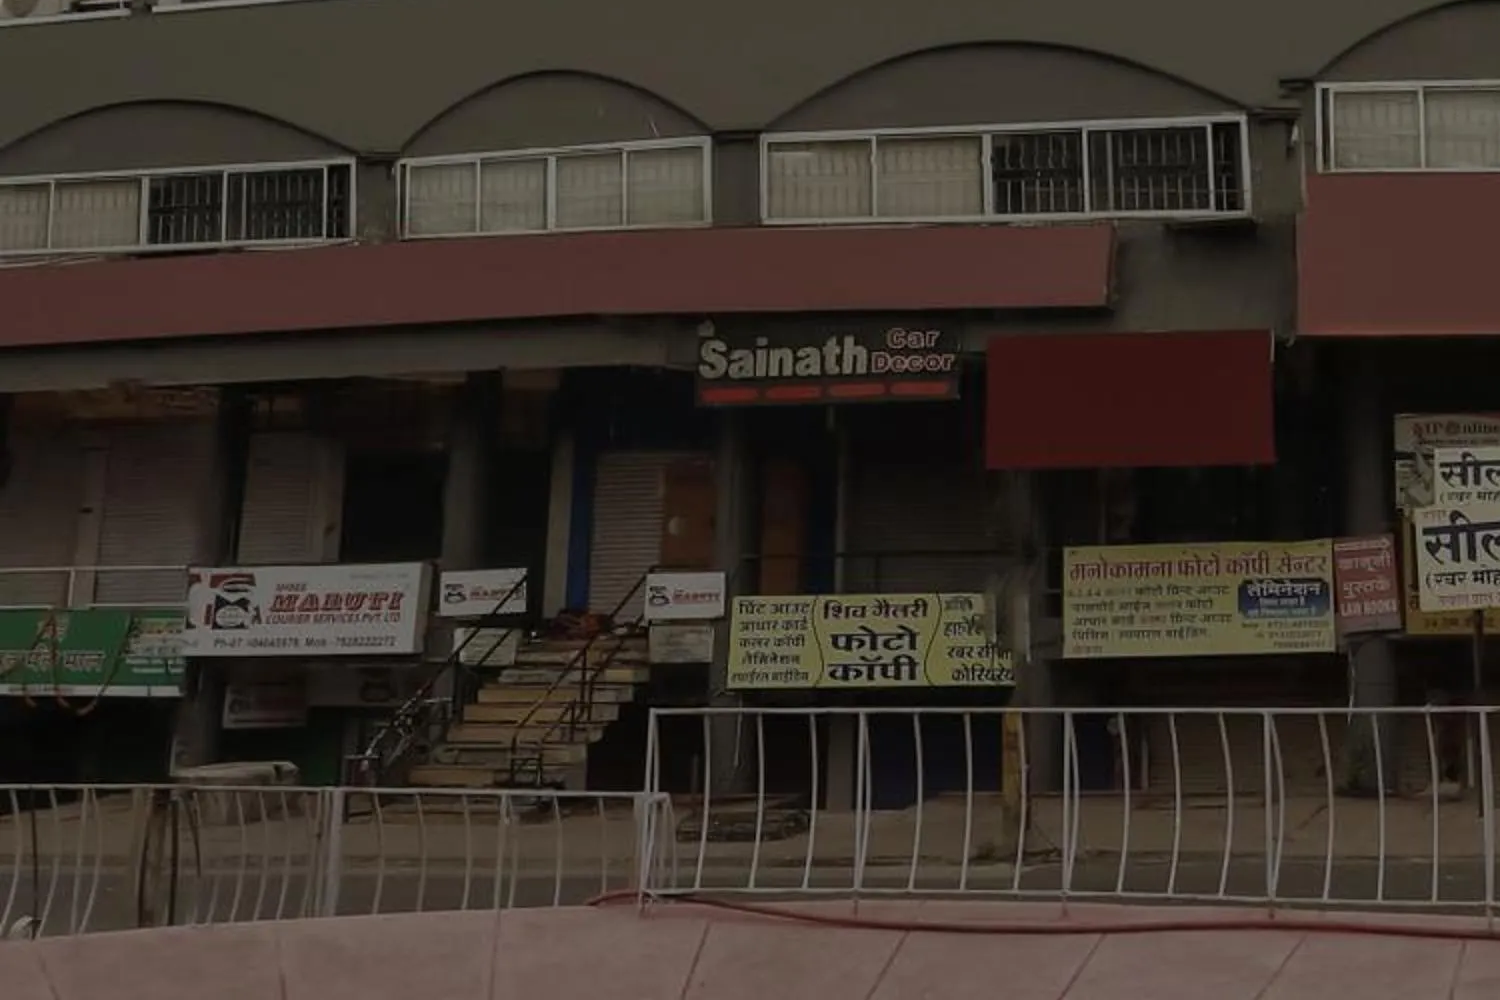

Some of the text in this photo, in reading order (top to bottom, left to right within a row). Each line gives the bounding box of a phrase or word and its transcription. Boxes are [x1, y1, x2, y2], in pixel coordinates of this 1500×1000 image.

[887, 327, 941, 350] Car
[699, 334, 868, 378] Sainath
[870, 352, 956, 374] Decor
[831, 626, 920, 652] फोटो
[829, 655, 921, 681] कॉपी
